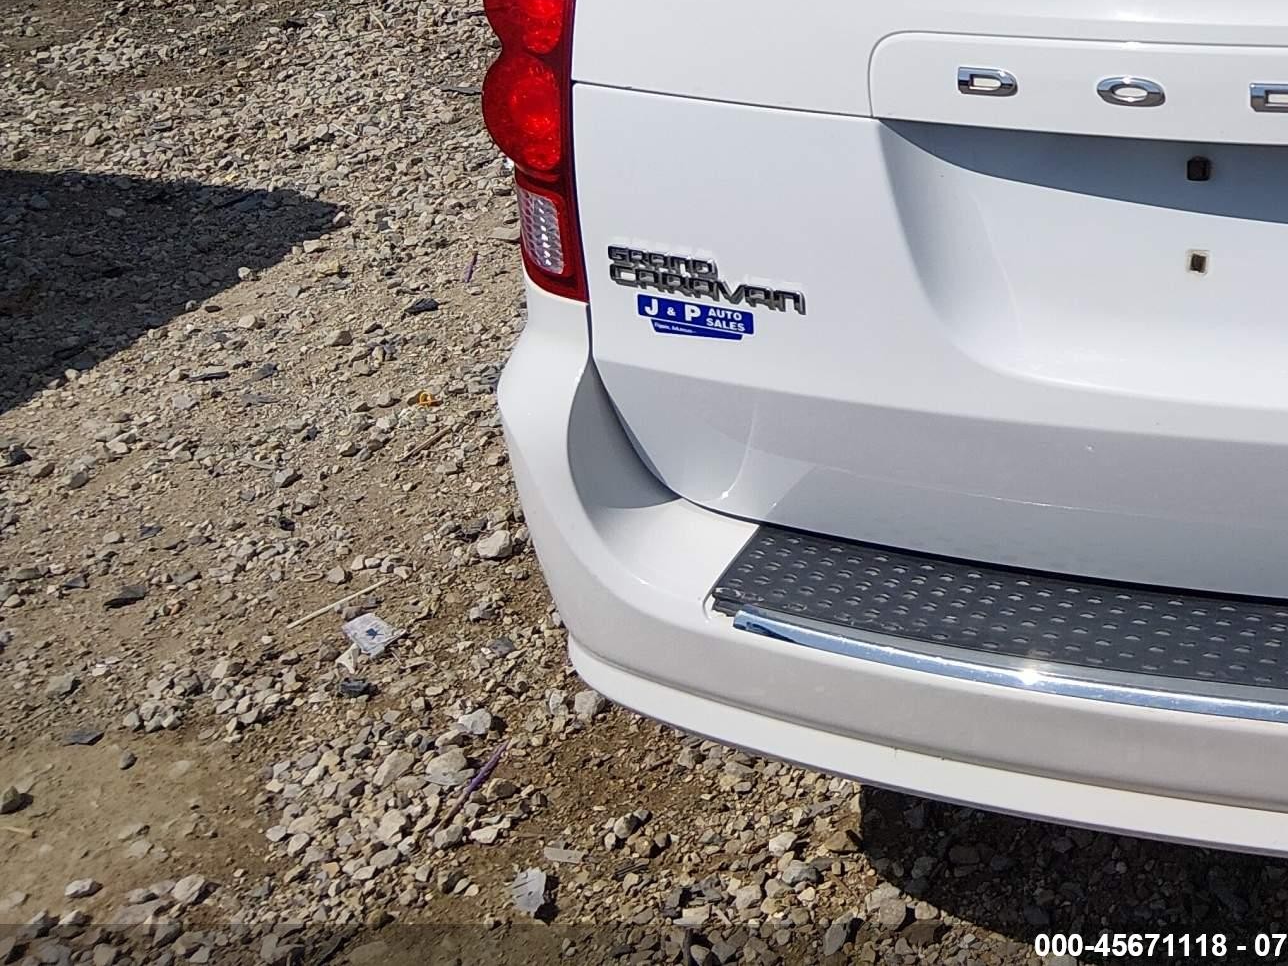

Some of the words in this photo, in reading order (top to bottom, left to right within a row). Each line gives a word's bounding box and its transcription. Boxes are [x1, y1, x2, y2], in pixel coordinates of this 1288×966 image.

[608, 245, 719, 279] GRAND
[609, 264, 807, 316] CARAVAN
[645, 299, 658, 315] J
[667, 307, 676, 317] &
[685, 305, 701, 321] P
[708, 308, 742, 321] AUTO
[706, 318, 746, 332] SALES
